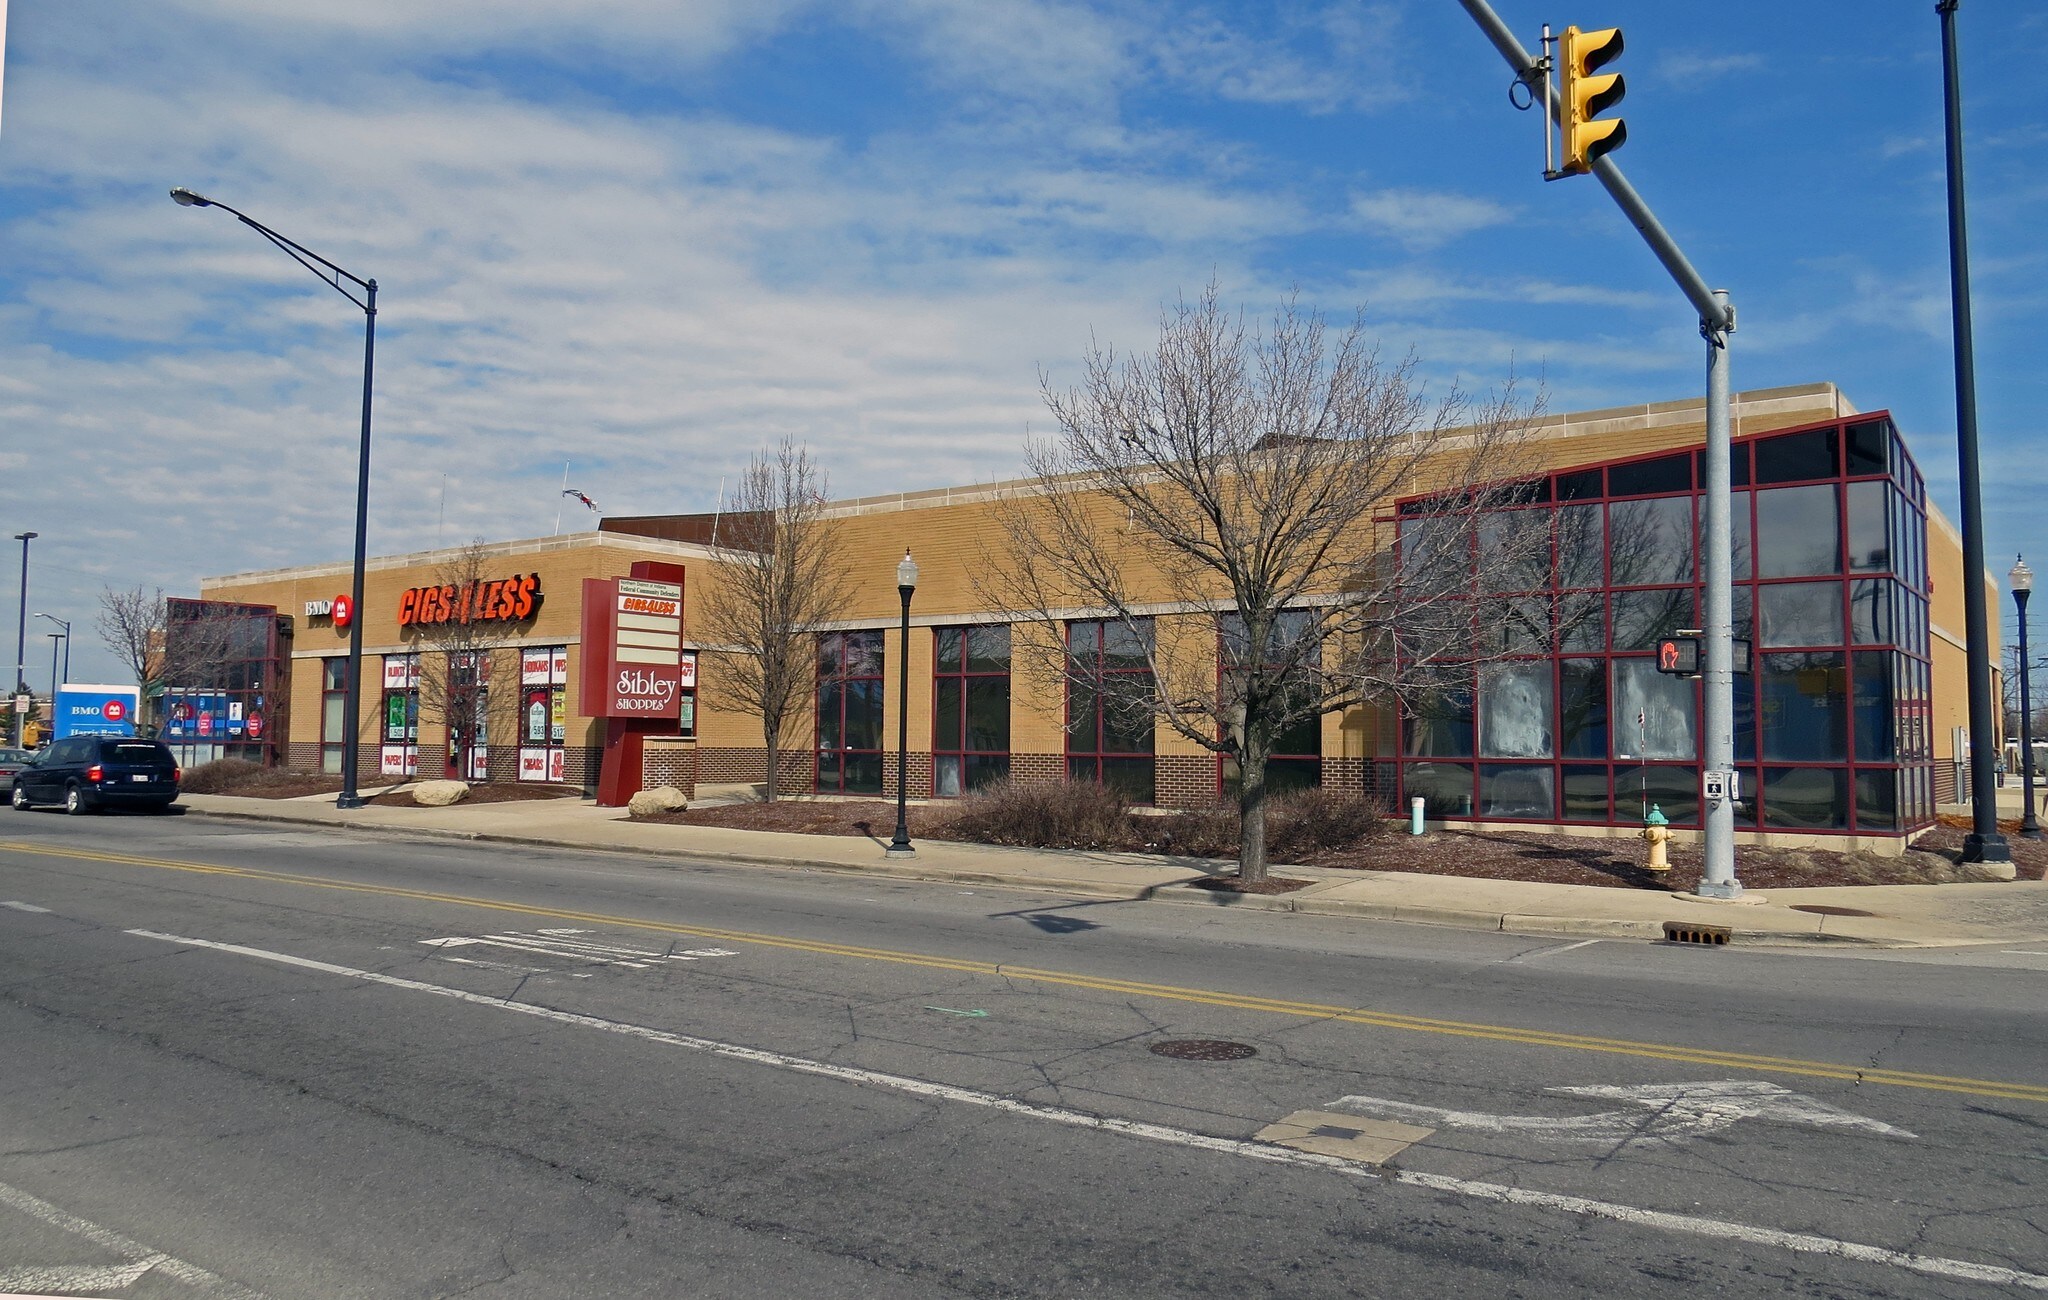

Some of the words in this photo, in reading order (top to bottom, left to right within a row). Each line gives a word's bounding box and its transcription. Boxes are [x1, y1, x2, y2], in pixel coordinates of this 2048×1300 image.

[620, 585, 636, 593] Federal
[636, 587, 660, 596] Community
[660, 590, 680, 598] Defenders
[304, 599, 331, 617] BMO
[616, 669, 677, 704] Sibley
[71, 706, 100, 715] BMO
[616, 698, 664, 711] SHOPPES
